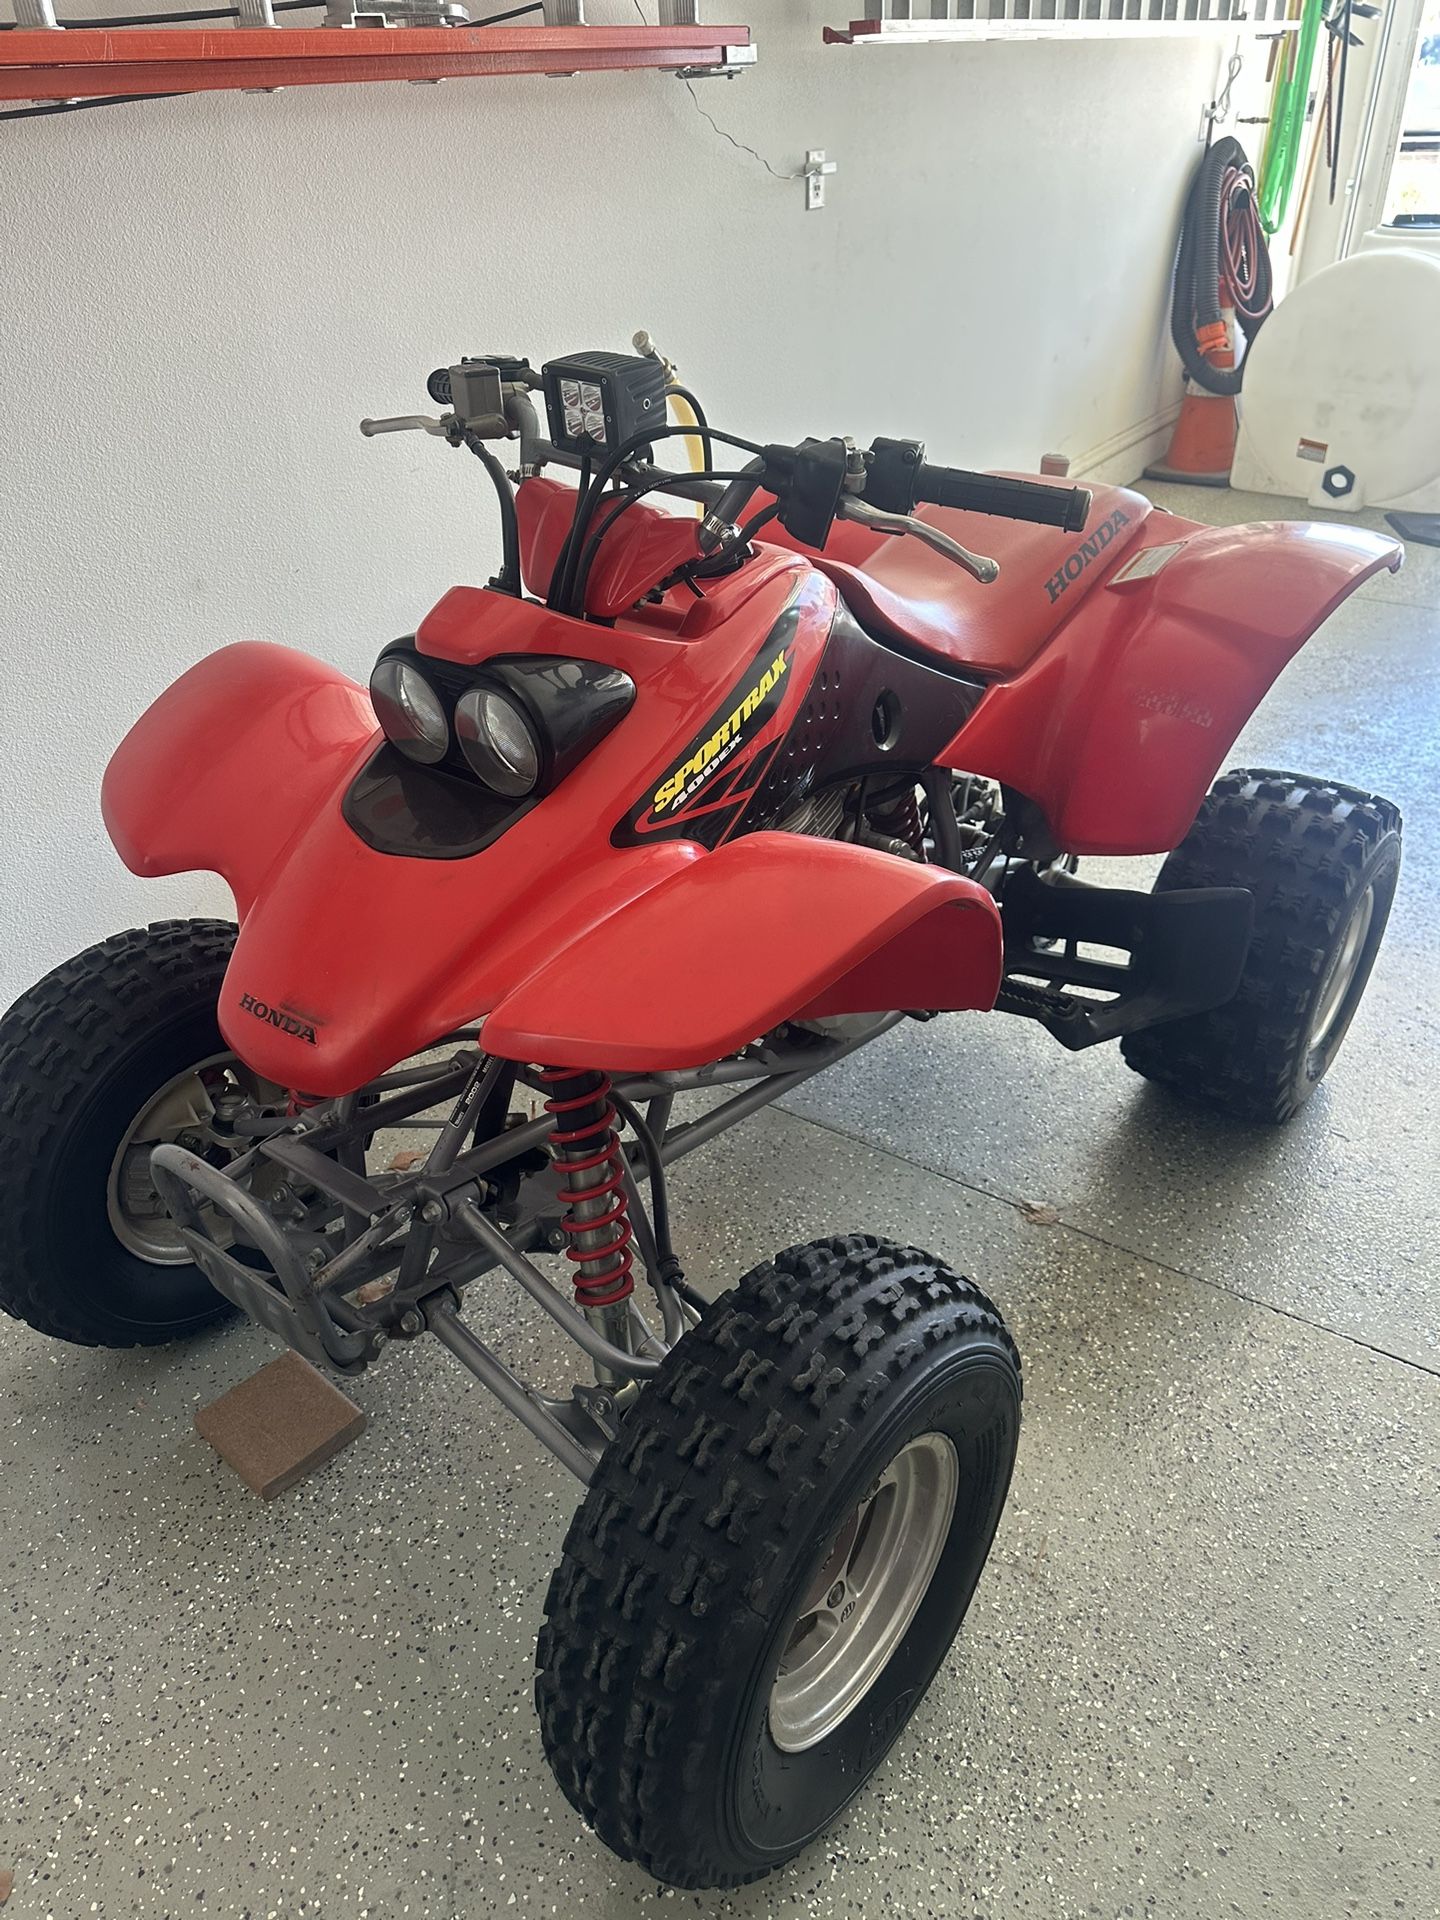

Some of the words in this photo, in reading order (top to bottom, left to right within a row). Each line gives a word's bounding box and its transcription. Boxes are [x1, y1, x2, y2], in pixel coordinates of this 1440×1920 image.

[1044, 510, 1130, 604] HONDA
[654, 649, 787, 813] SPORTRAX
[671, 734, 743, 811] 400EX
[239, 993, 317, 1045] HONDA
[465, 1081, 480, 1104] 2002
